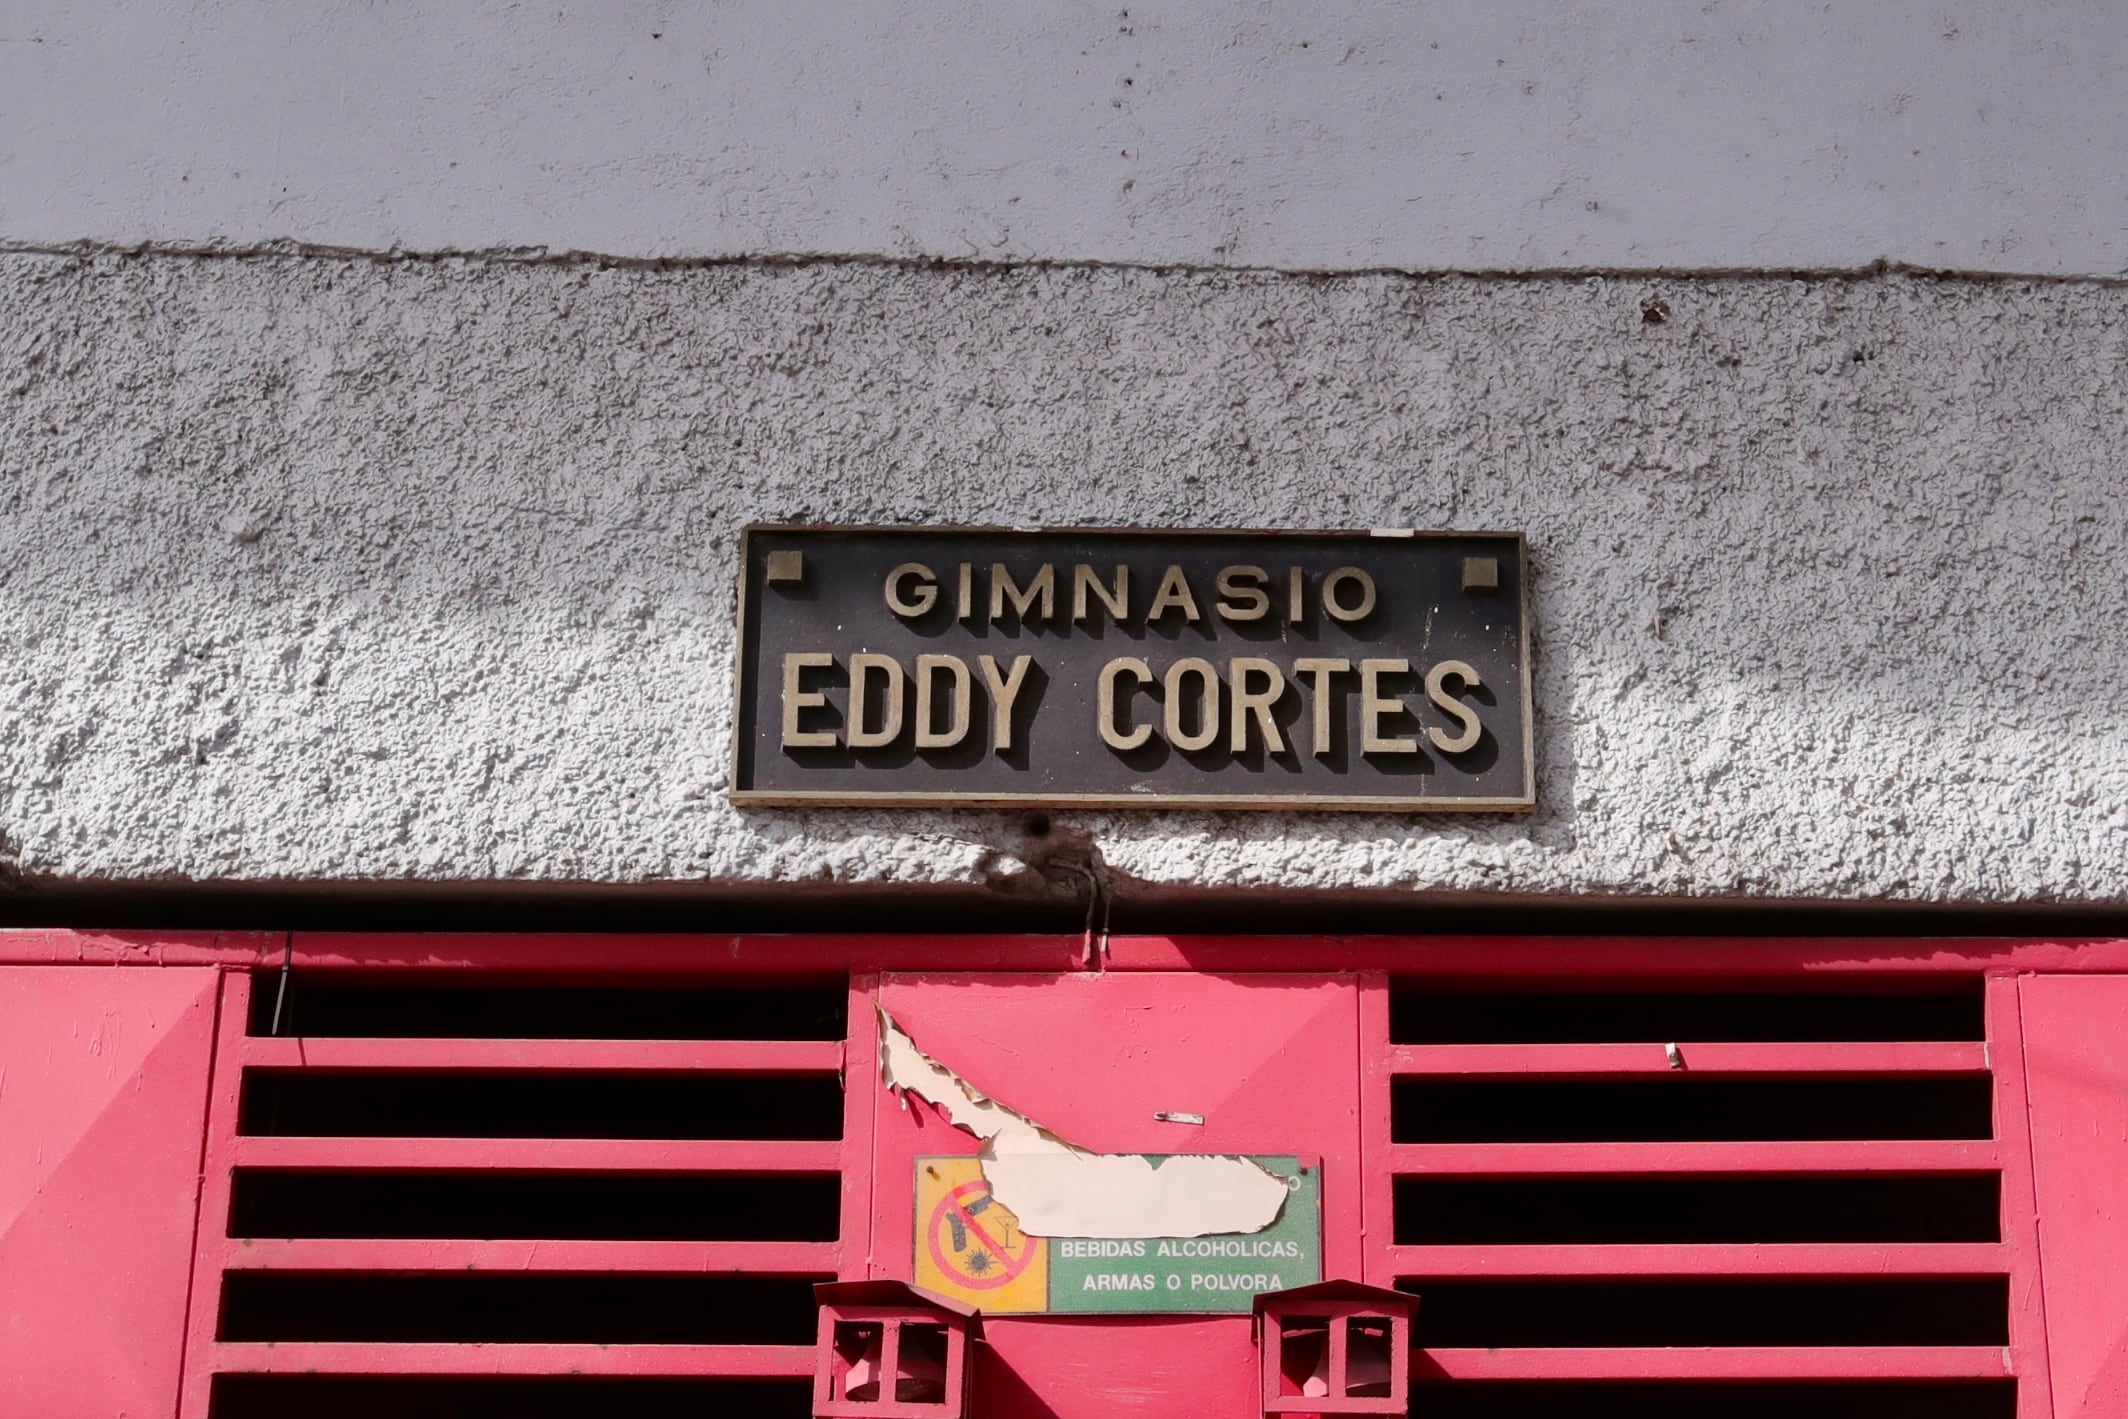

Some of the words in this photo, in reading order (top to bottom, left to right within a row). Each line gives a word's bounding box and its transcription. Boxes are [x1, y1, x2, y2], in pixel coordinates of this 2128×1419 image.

[884, 562, 1377, 622] GIMNASIO
[782, 652, 1032, 753] EDDY
[1097, 656, 1482, 754] CORTES
[1061, 1240, 1145, 1257] BEBIDAS
[1157, 1240, 1304, 1260] ALCOHOLICAS,
[1083, 1273, 1155, 1291] ARMAS
[1166, 1274, 1181, 1291] O
[1191, 1273, 1283, 1291] POLVORA
